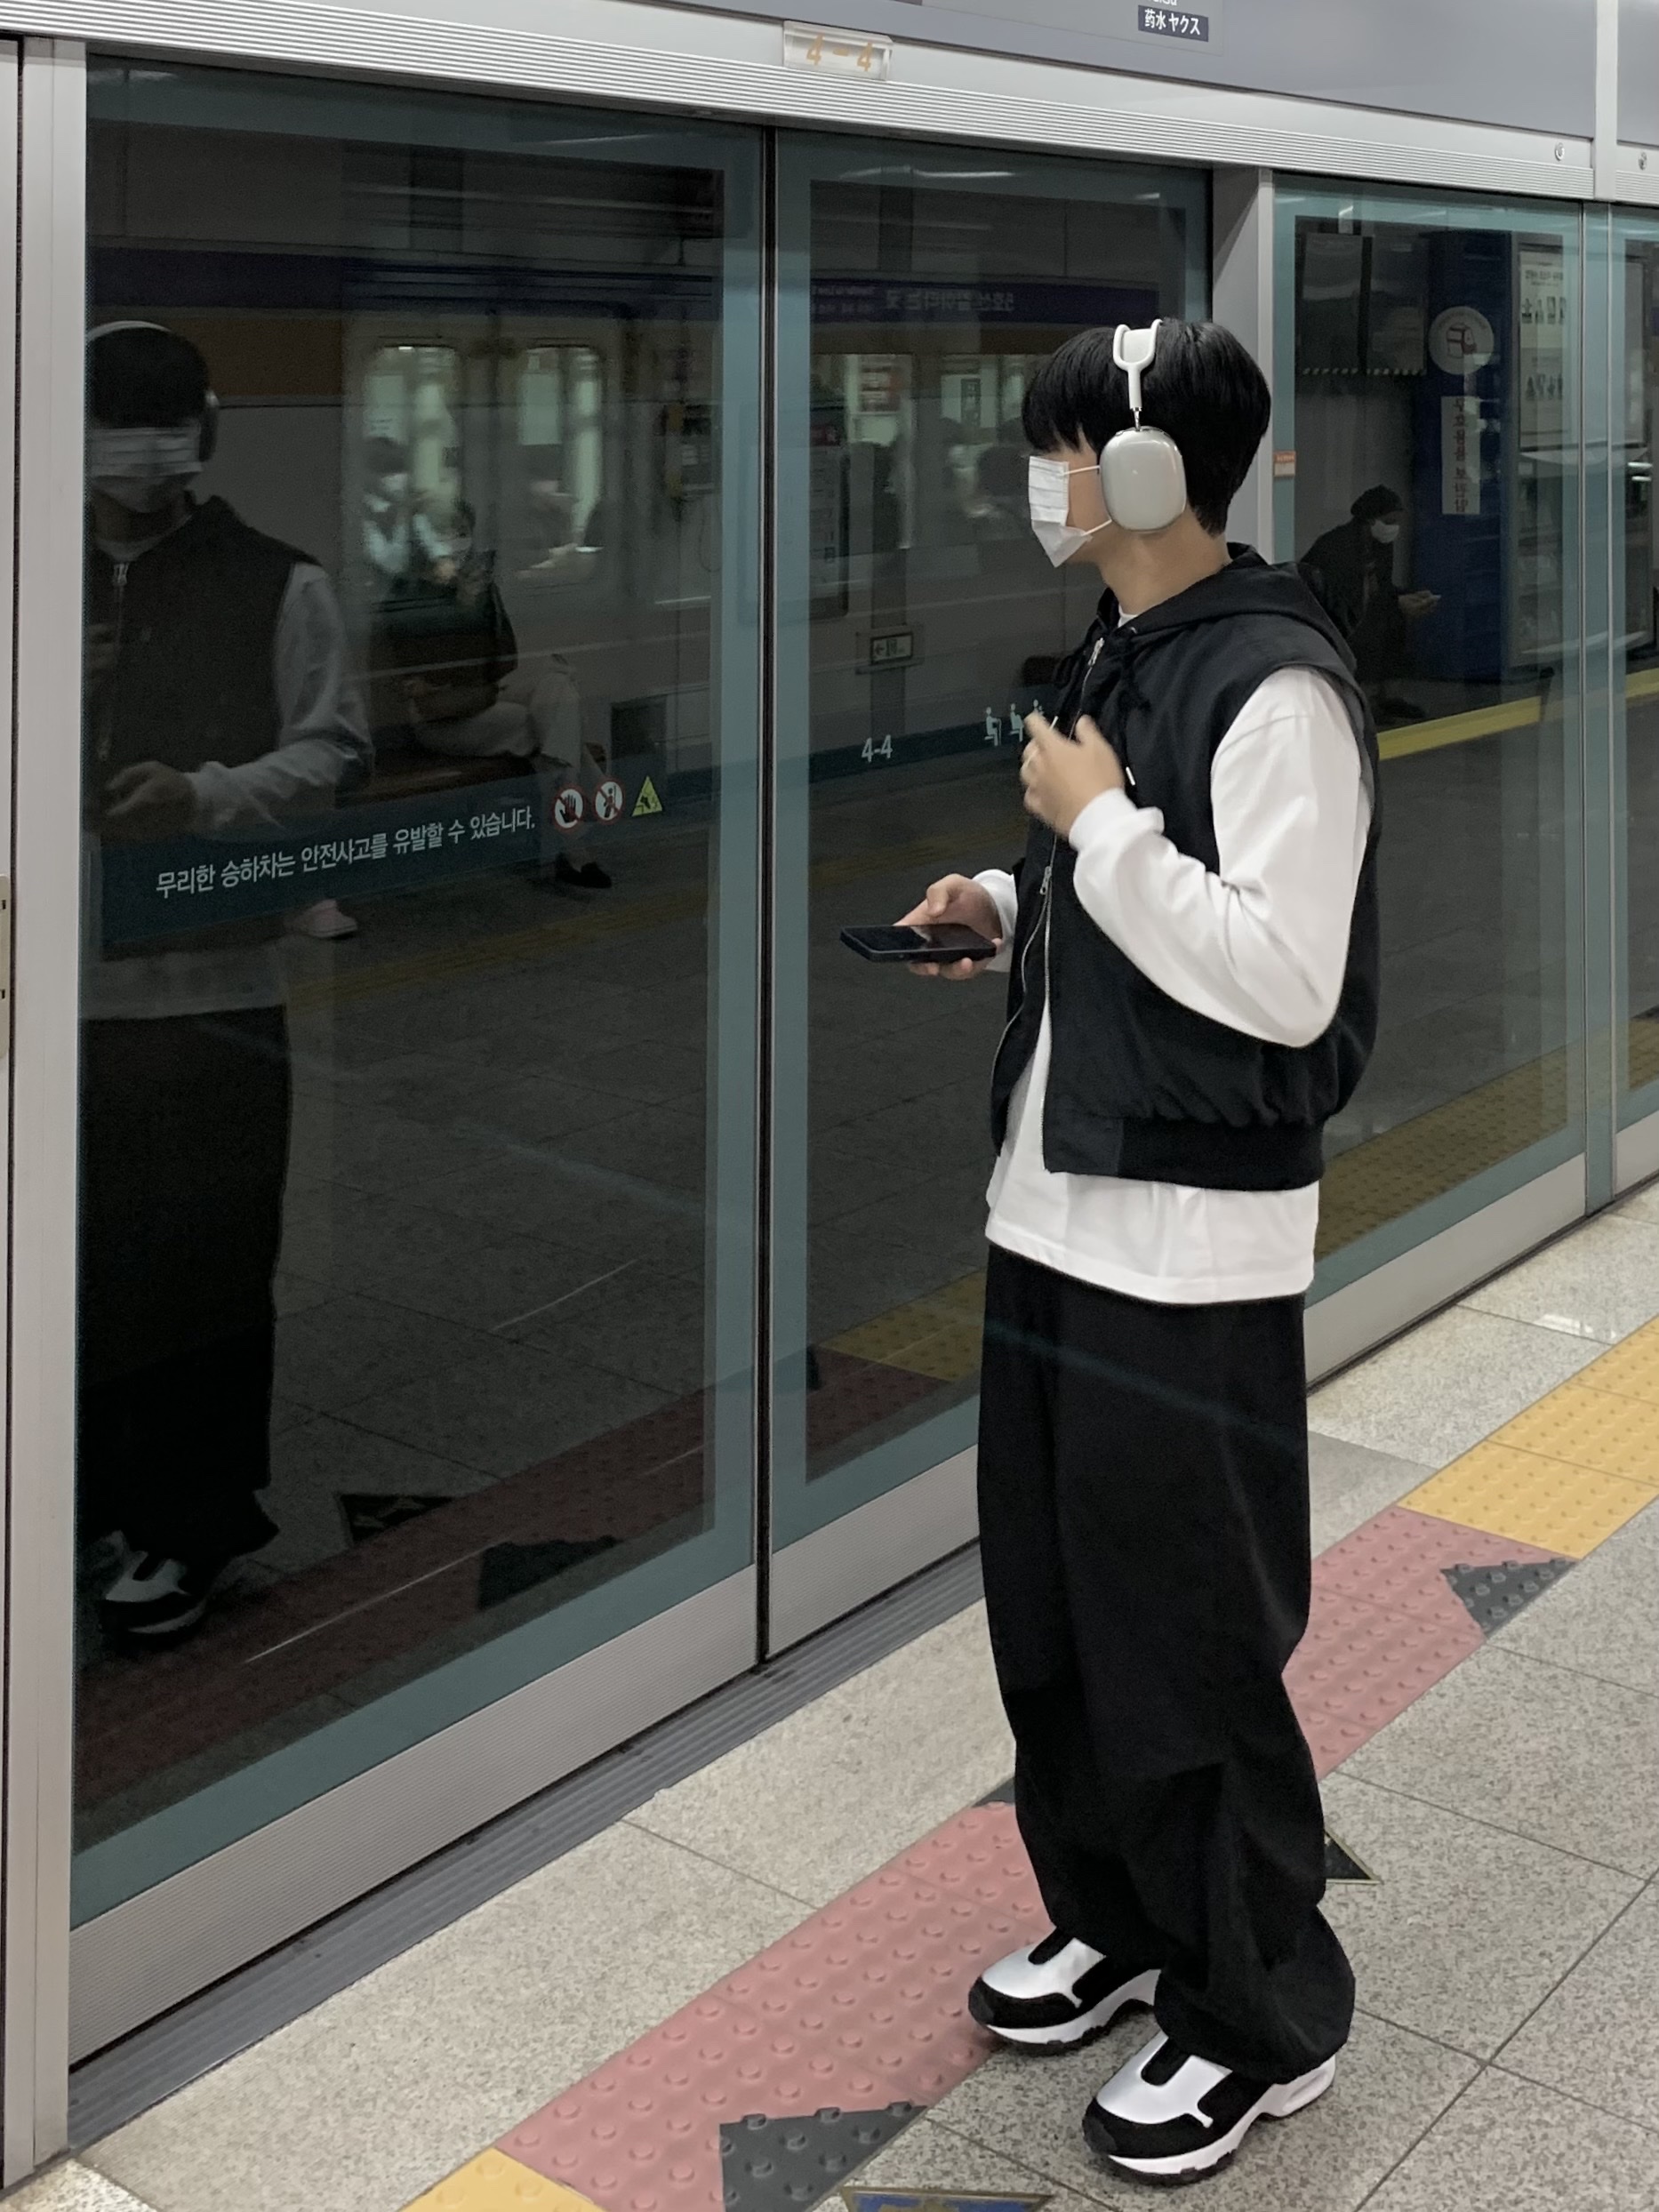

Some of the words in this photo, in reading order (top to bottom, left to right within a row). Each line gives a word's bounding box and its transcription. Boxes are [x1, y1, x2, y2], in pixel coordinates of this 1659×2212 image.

[1168, 12, 1201, 36] ヤクス
[861, 734, 894, 763] 4-4
[156, 863, 216, 899] 무리한
[220, 851, 296, 888] 승하차는
[301, 832, 389, 872] 안전사고를
[392, 821, 444, 854] 유발할
[448, 819, 466, 844] 수
[469, 805, 536, 841] 있습니다.
